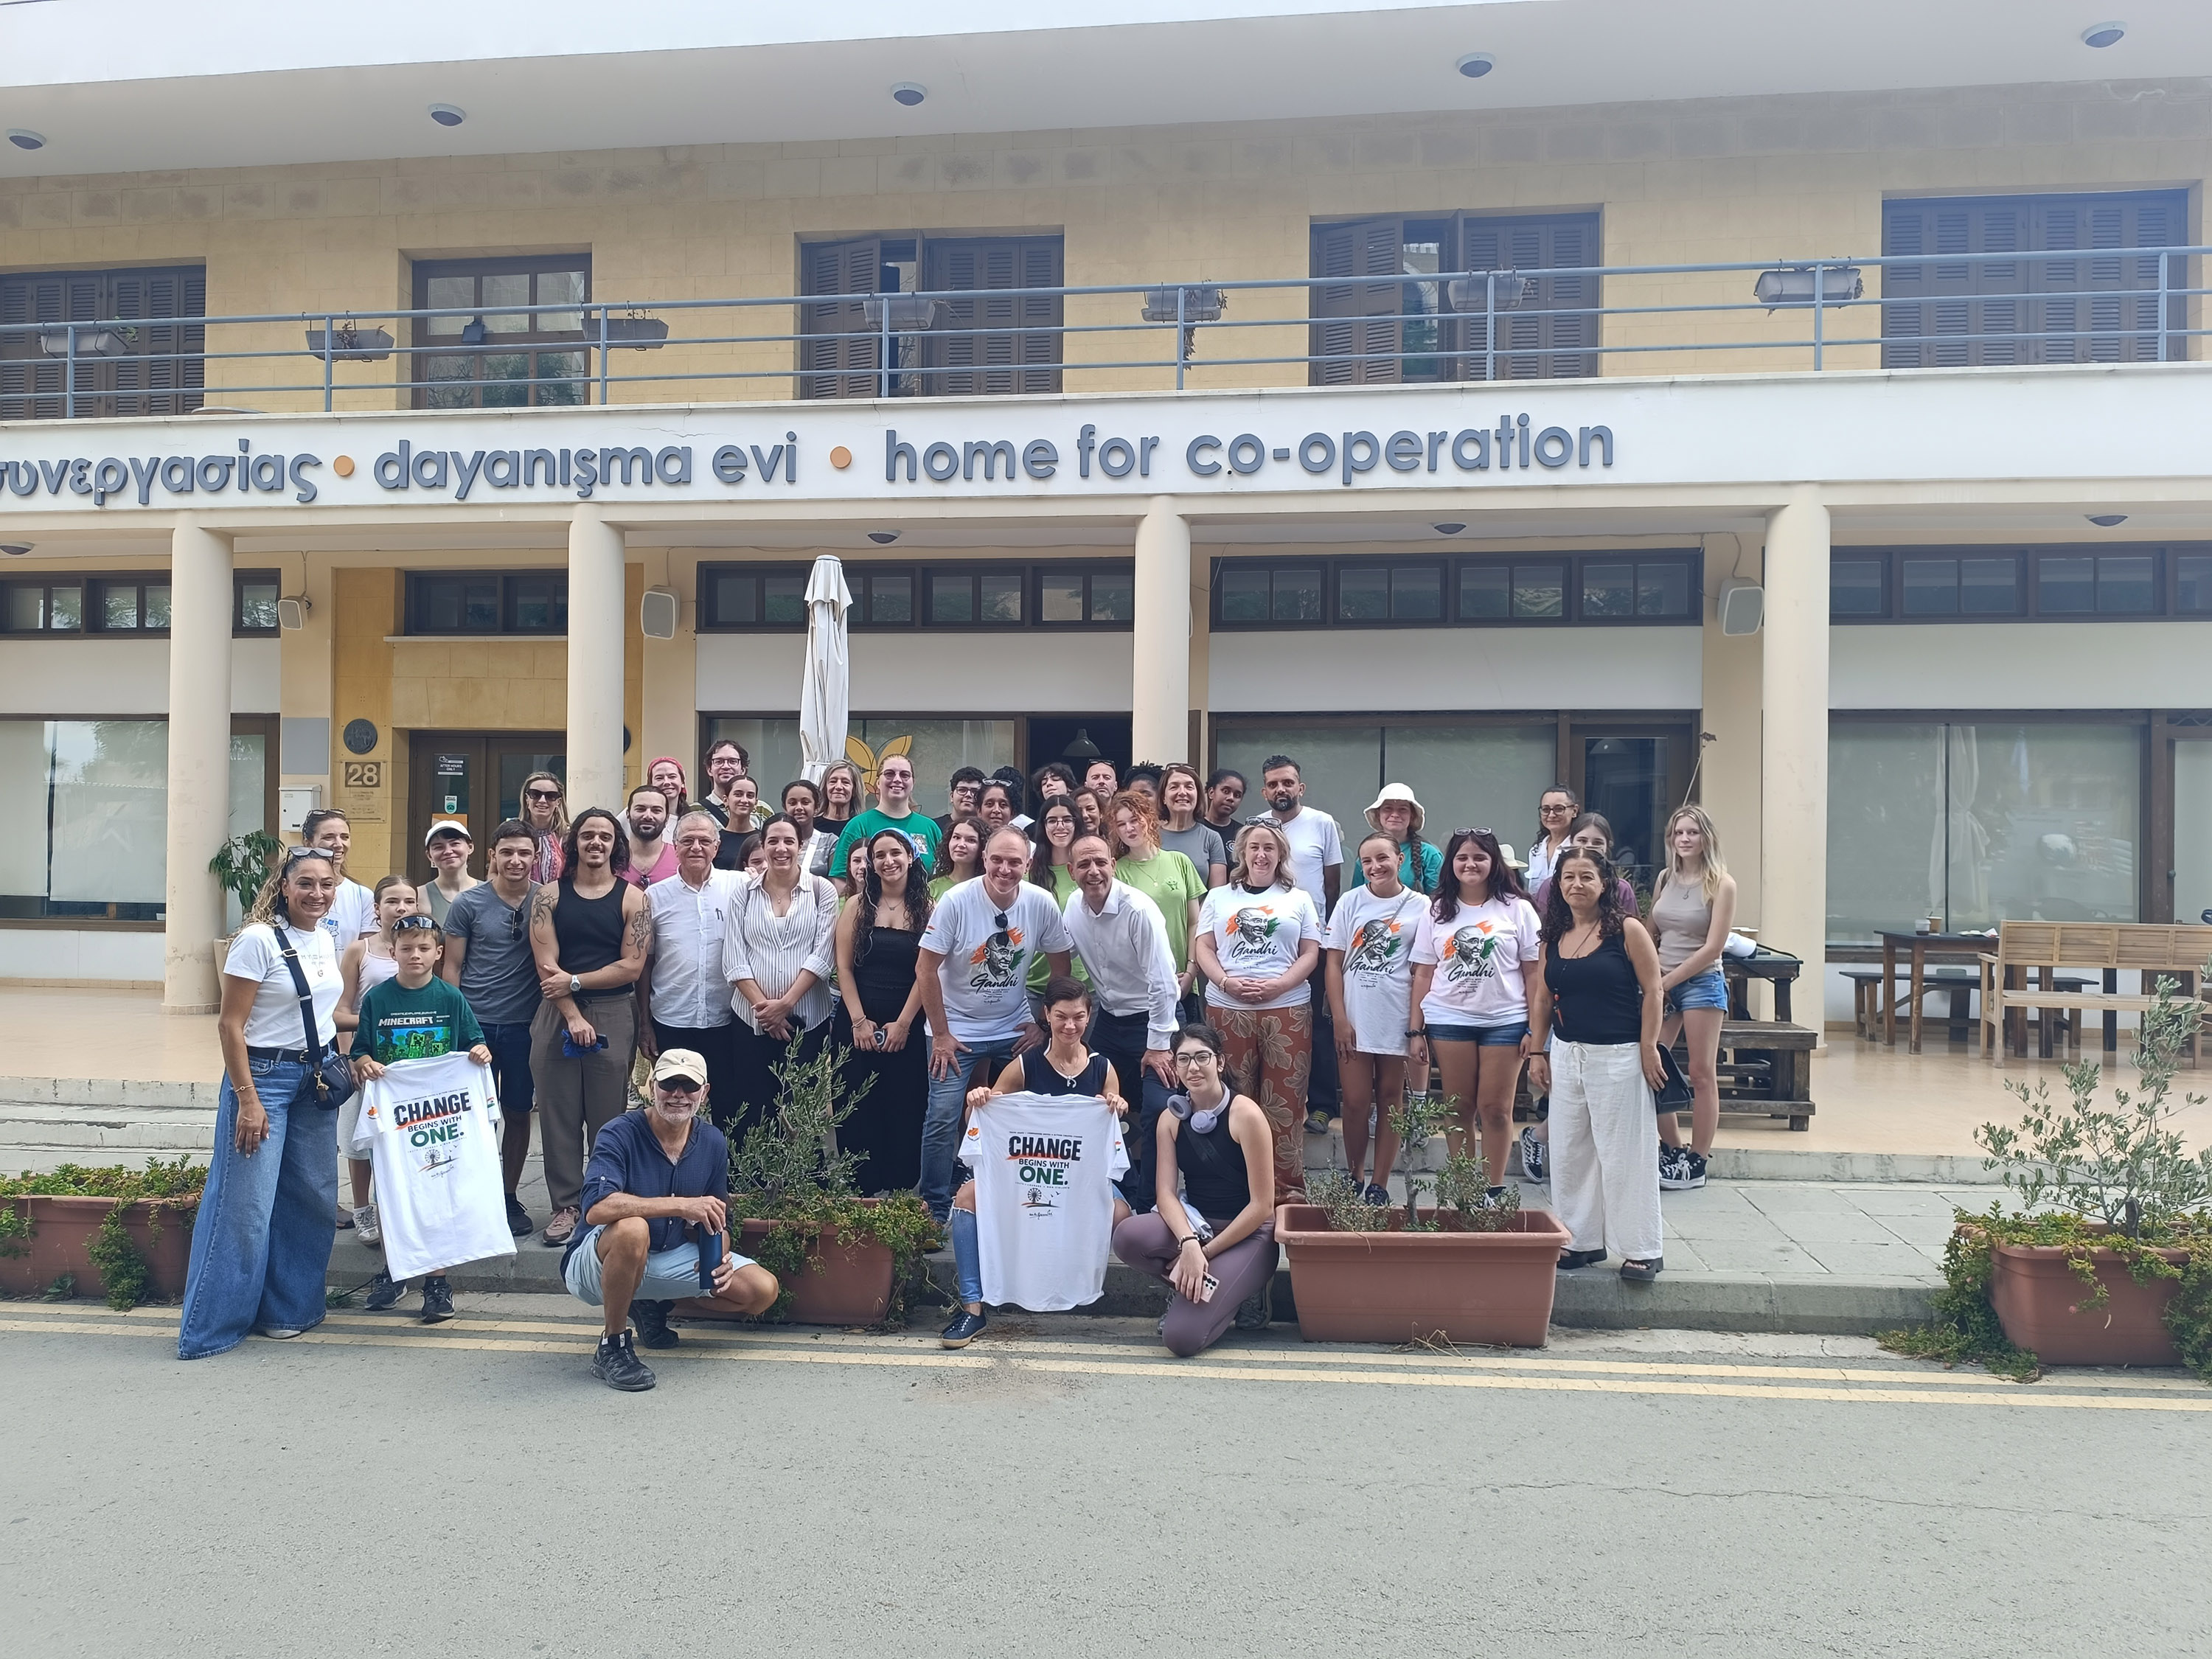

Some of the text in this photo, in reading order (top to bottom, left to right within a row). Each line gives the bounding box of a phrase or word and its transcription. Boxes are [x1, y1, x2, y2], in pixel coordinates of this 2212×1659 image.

[374, 412, 1614, 500] dayanışma evi home for co-operation
[347, 763, 378, 786] 28
[1231, 941, 1279, 964] Gandhi
[1350, 955, 1396, 978] Gandhi
[970, 973, 1018, 995] Gandhi
[378, 1017, 434, 1026] MINECRAFT
[394, 1091, 471, 1127] CHANGE
[408, 1115, 462, 1133] BEGINS WITH
[411, 1123, 465, 1147] ONE.
[1009, 1135, 1082, 1161] CHANGE
[1018, 1158, 1070, 1169] BEGINS WITH
[1019, 1166, 1068, 1186] ONE.
